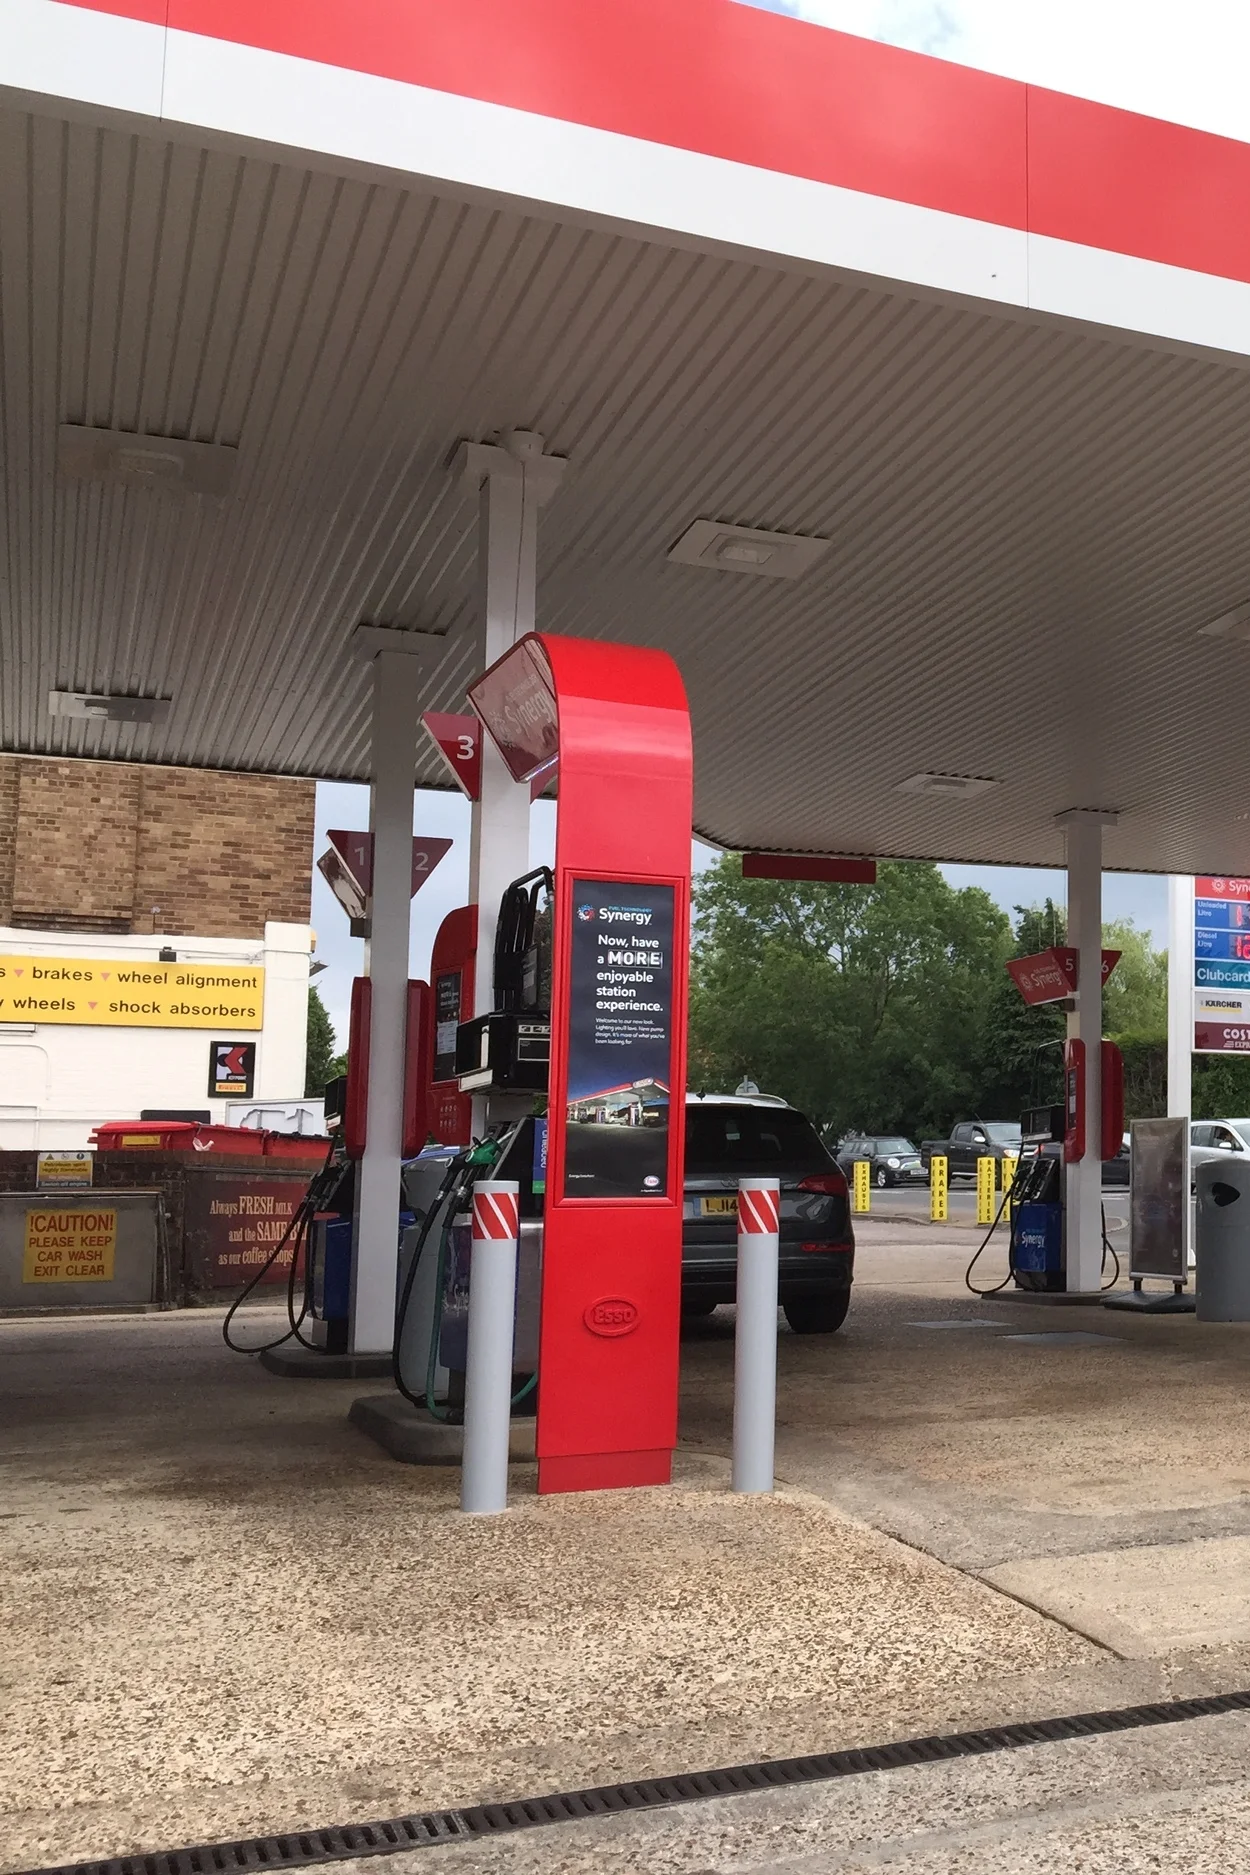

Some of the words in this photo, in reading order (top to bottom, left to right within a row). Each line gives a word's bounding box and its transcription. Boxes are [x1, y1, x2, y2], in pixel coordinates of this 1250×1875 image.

[456, 735, 475, 760] 3
[354, 847, 365, 866] 1
[415, 852, 429, 871] 2
[1198, 901, 1227, 909] Unleaded
[599, 908, 652, 925] Synergy
[598, 934, 629, 948] Now,
[631, 936, 660, 948] have
[597, 955, 605, 964] a
[608, 950, 661, 966] MORE
[1065, 958, 1074, 972] 5
[32, 967, 93, 981] brakes
[1101, 960, 1109, 973] 6
[117, 971, 168, 984] wheel
[175, 973, 257, 989] alignment
[596, 970, 654, 985] enjoyable
[1030, 967, 1063, 989] Synerg
[1197, 968, 1250, 983] Clubcard
[596, 986, 636, 998] station
[13, 997, 76, 1010] wheels
[109, 1000, 161, 1014] shock
[170, 1002, 256, 1017] absorbers
[596, 1000, 664, 1013] experience.
[209, 1200, 238, 1218] Always
[239, 1196, 274, 1214] FRESH
[275, 1203, 293, 1214] MILK
[30, 1214, 114, 1233] !CAUTION!
[229, 1228, 243, 1242] and
[245, 1227, 256, 1241] the
[257, 1221, 288, 1241] SAME
[29, 1237, 74, 1248] PLEASE
[81, 1236, 112, 1246] KEEP
[1021, 1231, 1045, 1248] Synergy
[37, 1251, 62, 1262] CAR
[68, 1250, 102, 1261] WASH
[218, 1254, 227, 1265] as
[229, 1254, 241, 1264] our
[242, 1246, 267, 1264] coffee
[34, 1265, 60, 1277] EXIT
[65, 1264, 105, 1276] CLEAR
